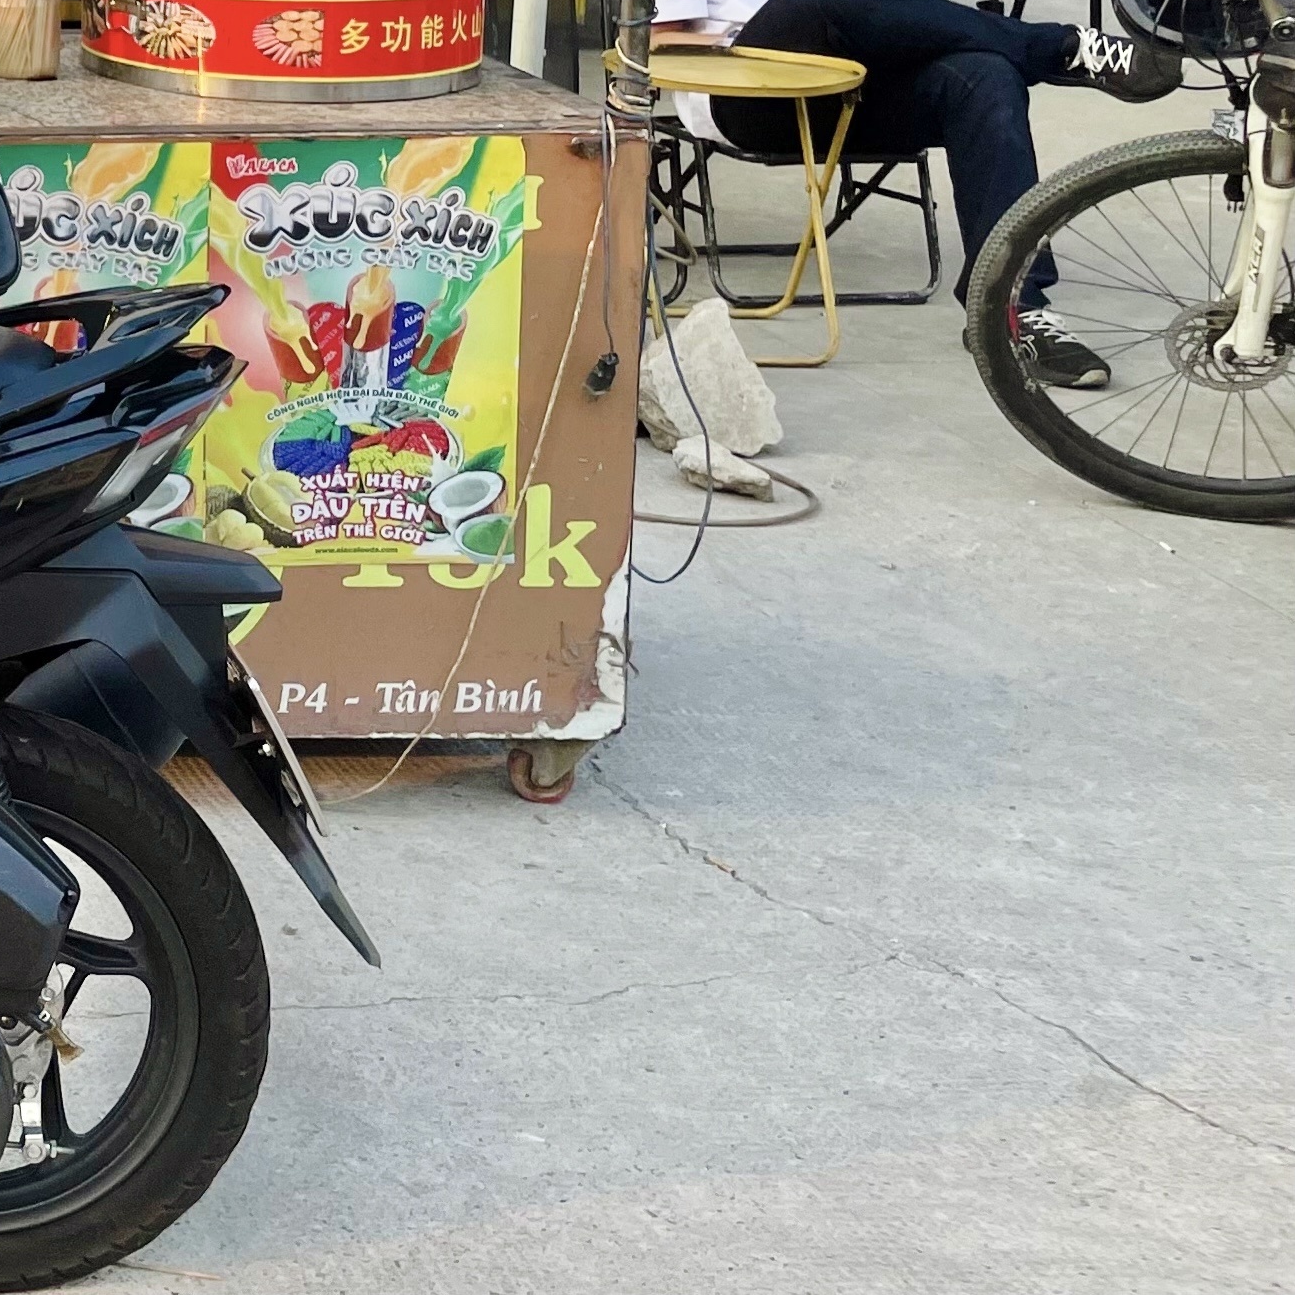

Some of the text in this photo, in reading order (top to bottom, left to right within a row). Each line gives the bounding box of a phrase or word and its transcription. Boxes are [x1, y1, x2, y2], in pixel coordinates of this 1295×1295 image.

[10, 168, 180, 258] ÚC XÍCH
[244, 165, 396, 247] XÚC
[400, 192, 495, 254] XÍCH
[359, 493, 428, 524] TIÊN
[276, 681, 328, 714] P4
[375, 678, 441, 715] Tân
[453, 677, 544, 715] Bình
